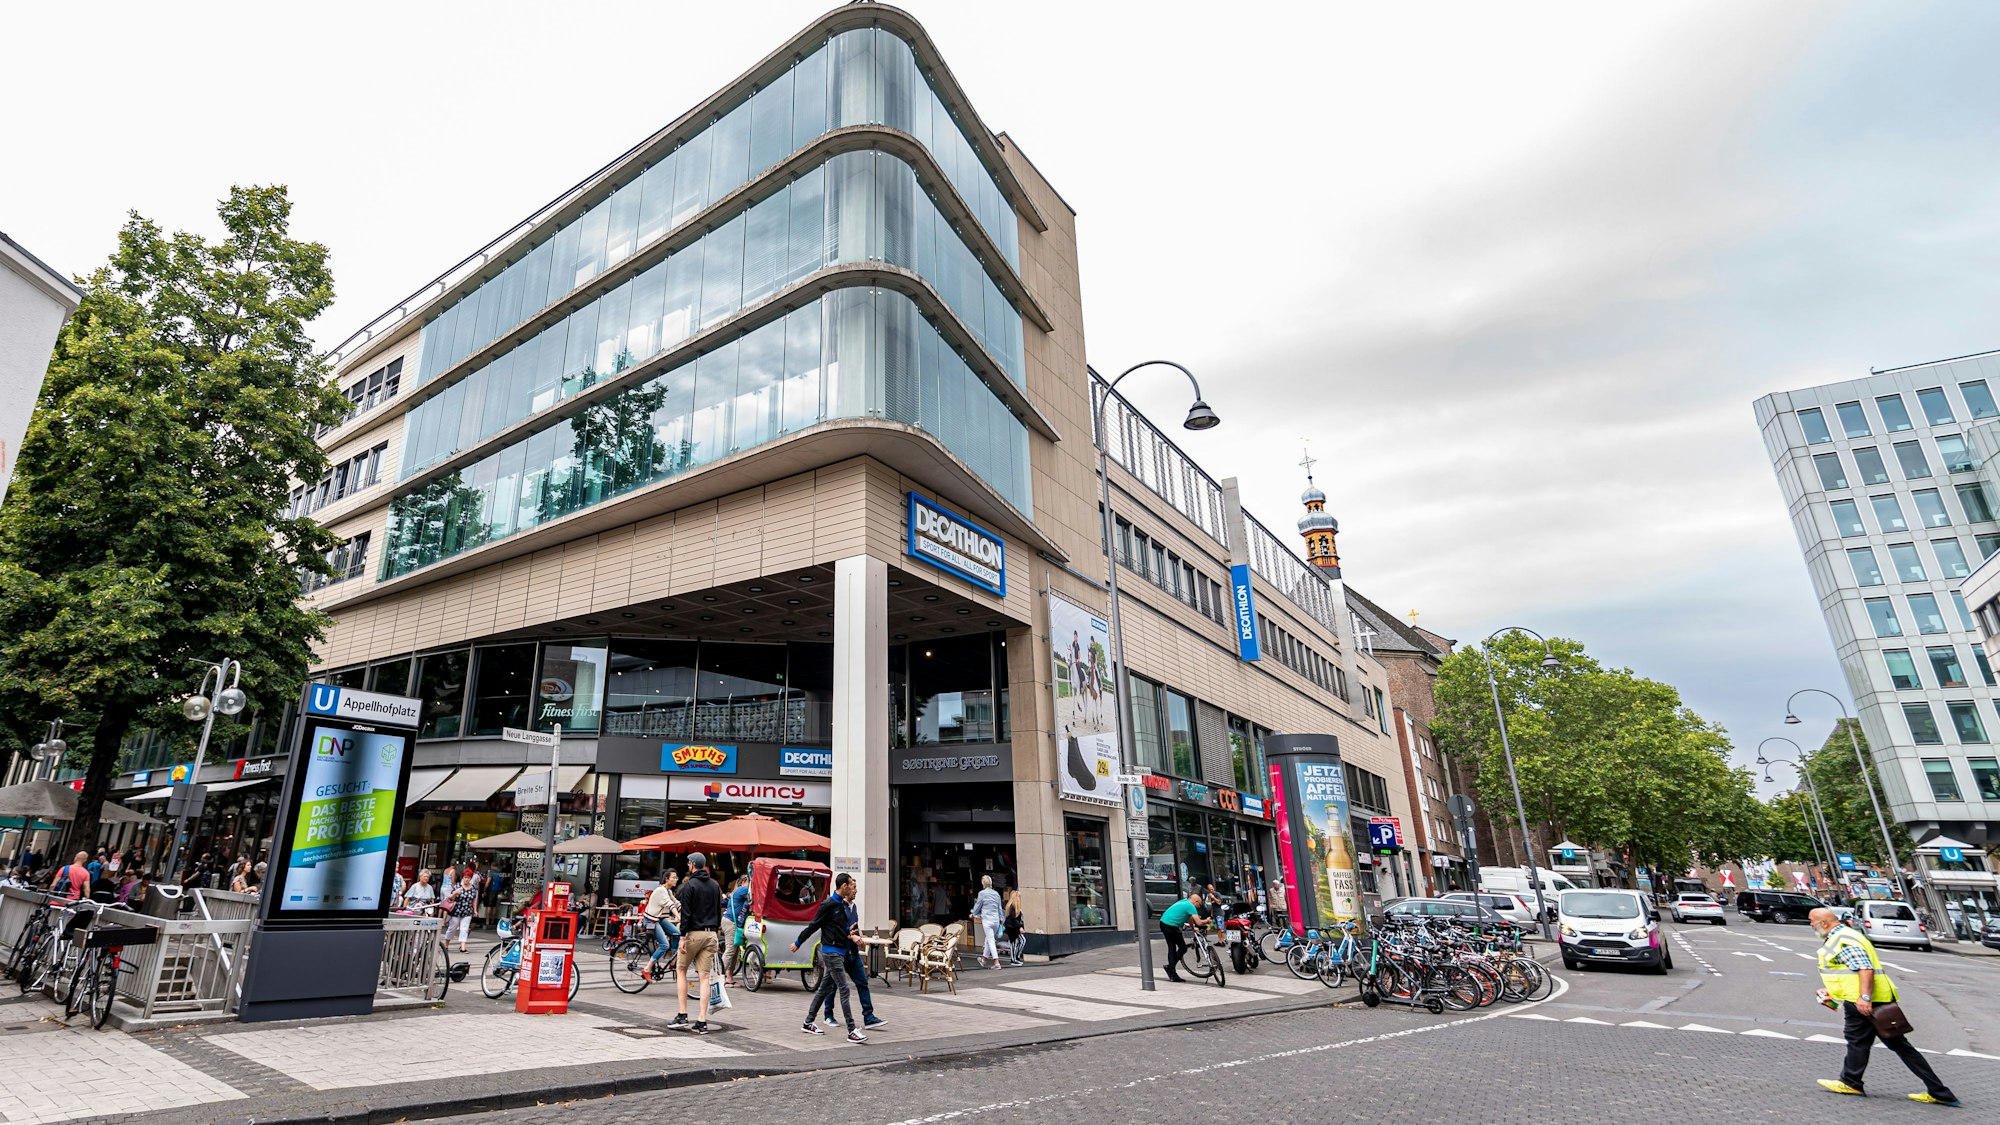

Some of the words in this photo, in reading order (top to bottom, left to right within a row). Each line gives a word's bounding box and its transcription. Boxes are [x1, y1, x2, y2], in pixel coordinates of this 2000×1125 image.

[916, 503, 1002, 569] DECATHLON
[923, 540, 940, 554] SPORT
[941, 548, 951, 559] FOR
[952, 554, 961, 565] ALL
[963, 559, 973, 571] ALL
[973, 564, 983, 574] FOR
[983, 568, 998, 580] SPORT
[1237, 585, 1252, 639] DECATHLON
[314, 687, 336, 711] U
[343, 697, 417, 717] Appellhofplatz
[352, 724, 375, 732] JCDecaux
[506, 730, 521, 739] Neue
[522, 732, 551, 743] Langgasse
[318, 736, 354, 756] DNP
[675, 747, 725, 764] SMYTHS
[784, 752, 832, 765] DECATHL
[902, 757, 958, 771] SØSTRENE
[960, 755, 999, 770] GRENE
[316, 780, 371, 797] GESUCHT:
[517, 787, 534, 795] Breite
[534, 785, 544, 793] Str.
[1306, 784, 1345, 796] APFEL
[311, 803, 336, 817] DAS
[340, 798, 377, 813] BESTE
[1219, 789, 1238, 811] CCC
[306, 817, 375, 842] PROJEKT
[1380, 827, 1393, 844] P
[1564, 849, 1572, 857] U
[1944, 849, 1959, 860] U
[1335, 880, 1354, 889] FASS
